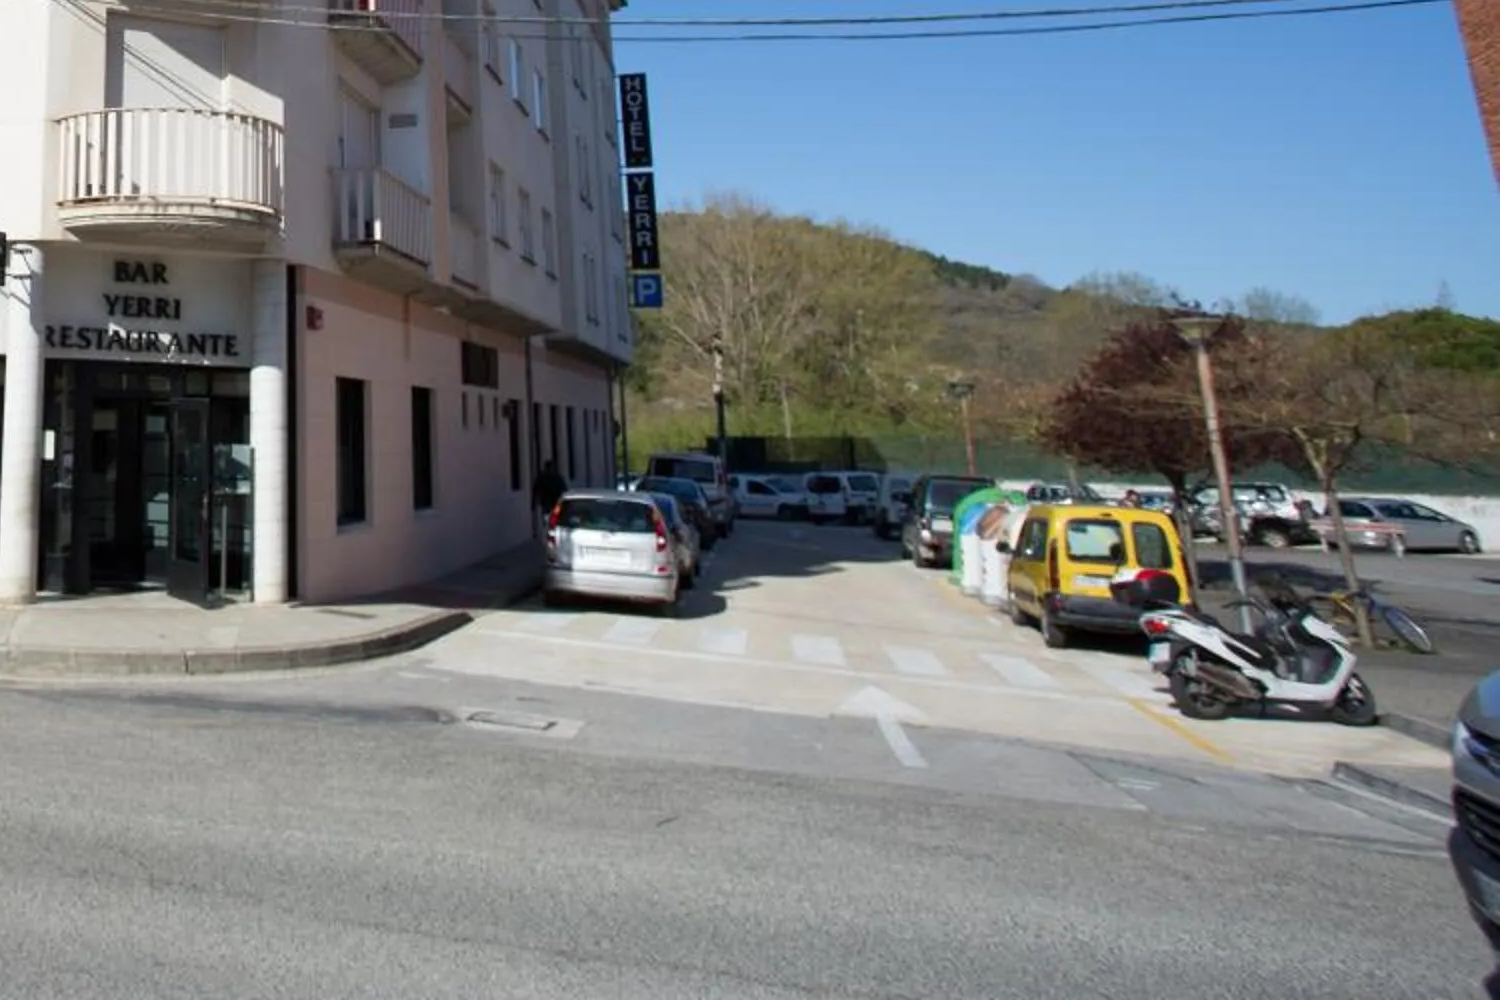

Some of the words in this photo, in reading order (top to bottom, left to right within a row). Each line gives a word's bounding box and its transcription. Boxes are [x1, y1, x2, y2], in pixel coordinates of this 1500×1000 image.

[626, 77, 645, 151] HOTEL
[633, 176, 651, 265] YERRI
[113, 260, 169, 285] BAR
[637, 278, 657, 304] P
[103, 293, 181, 320] YERRI
